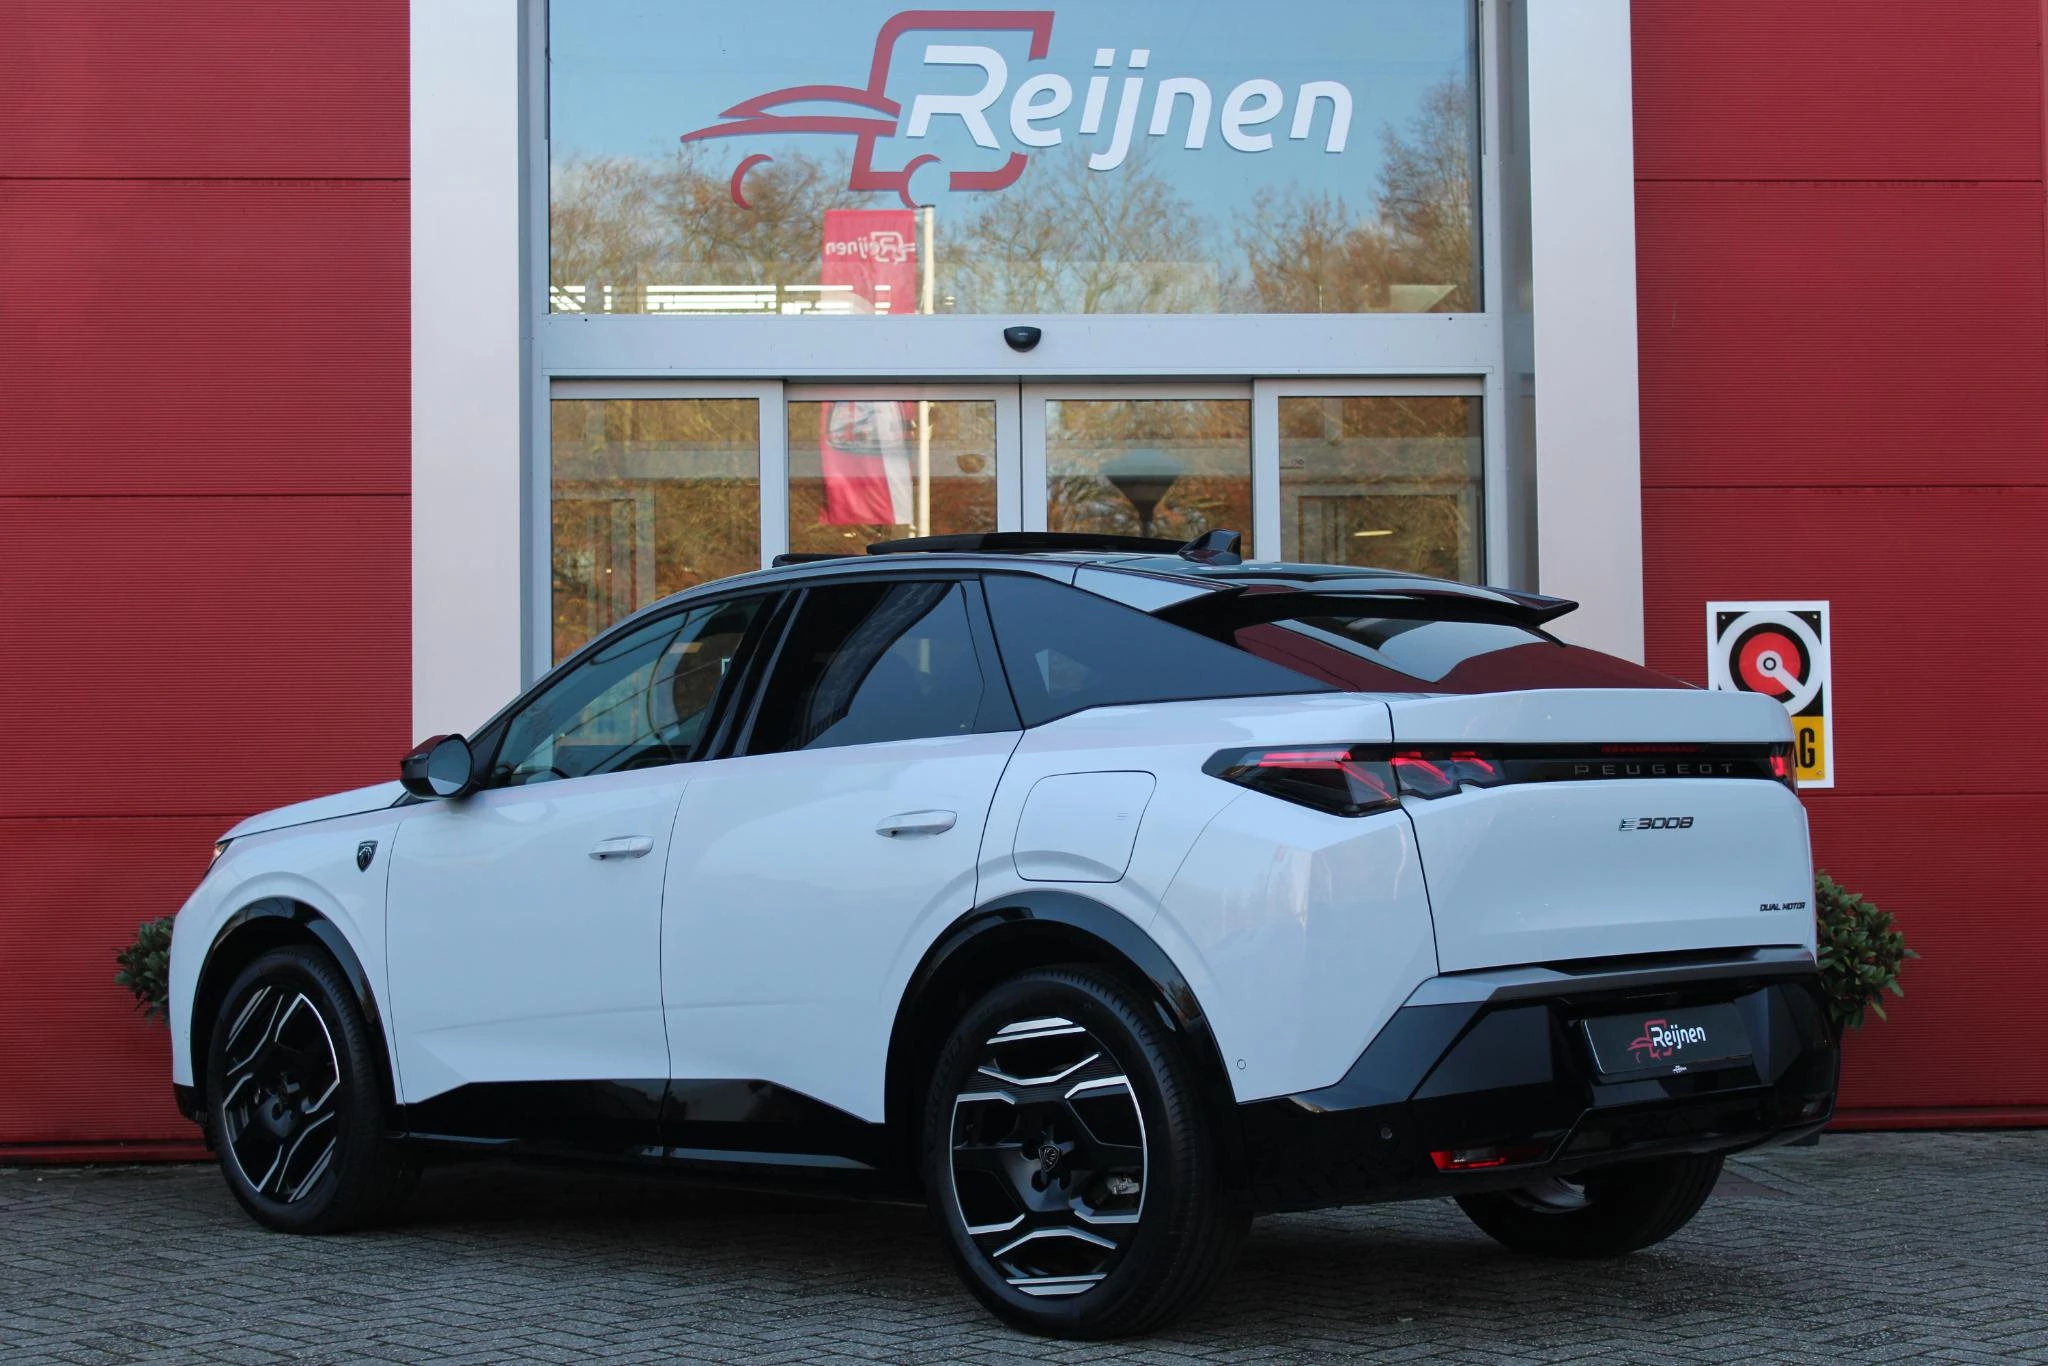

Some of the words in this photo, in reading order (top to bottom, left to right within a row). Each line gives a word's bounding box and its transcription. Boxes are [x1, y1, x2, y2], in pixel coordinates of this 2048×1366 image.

[906, 45, 1353, 170] Reijnen
[1574, 764, 1733, 776] PEUGEOT
[1760, 903, 1781, 911] DUAL
[1782, 902, 1806, 910] MOTOR
[1651, 1024, 1706, 1050] Reijnen
